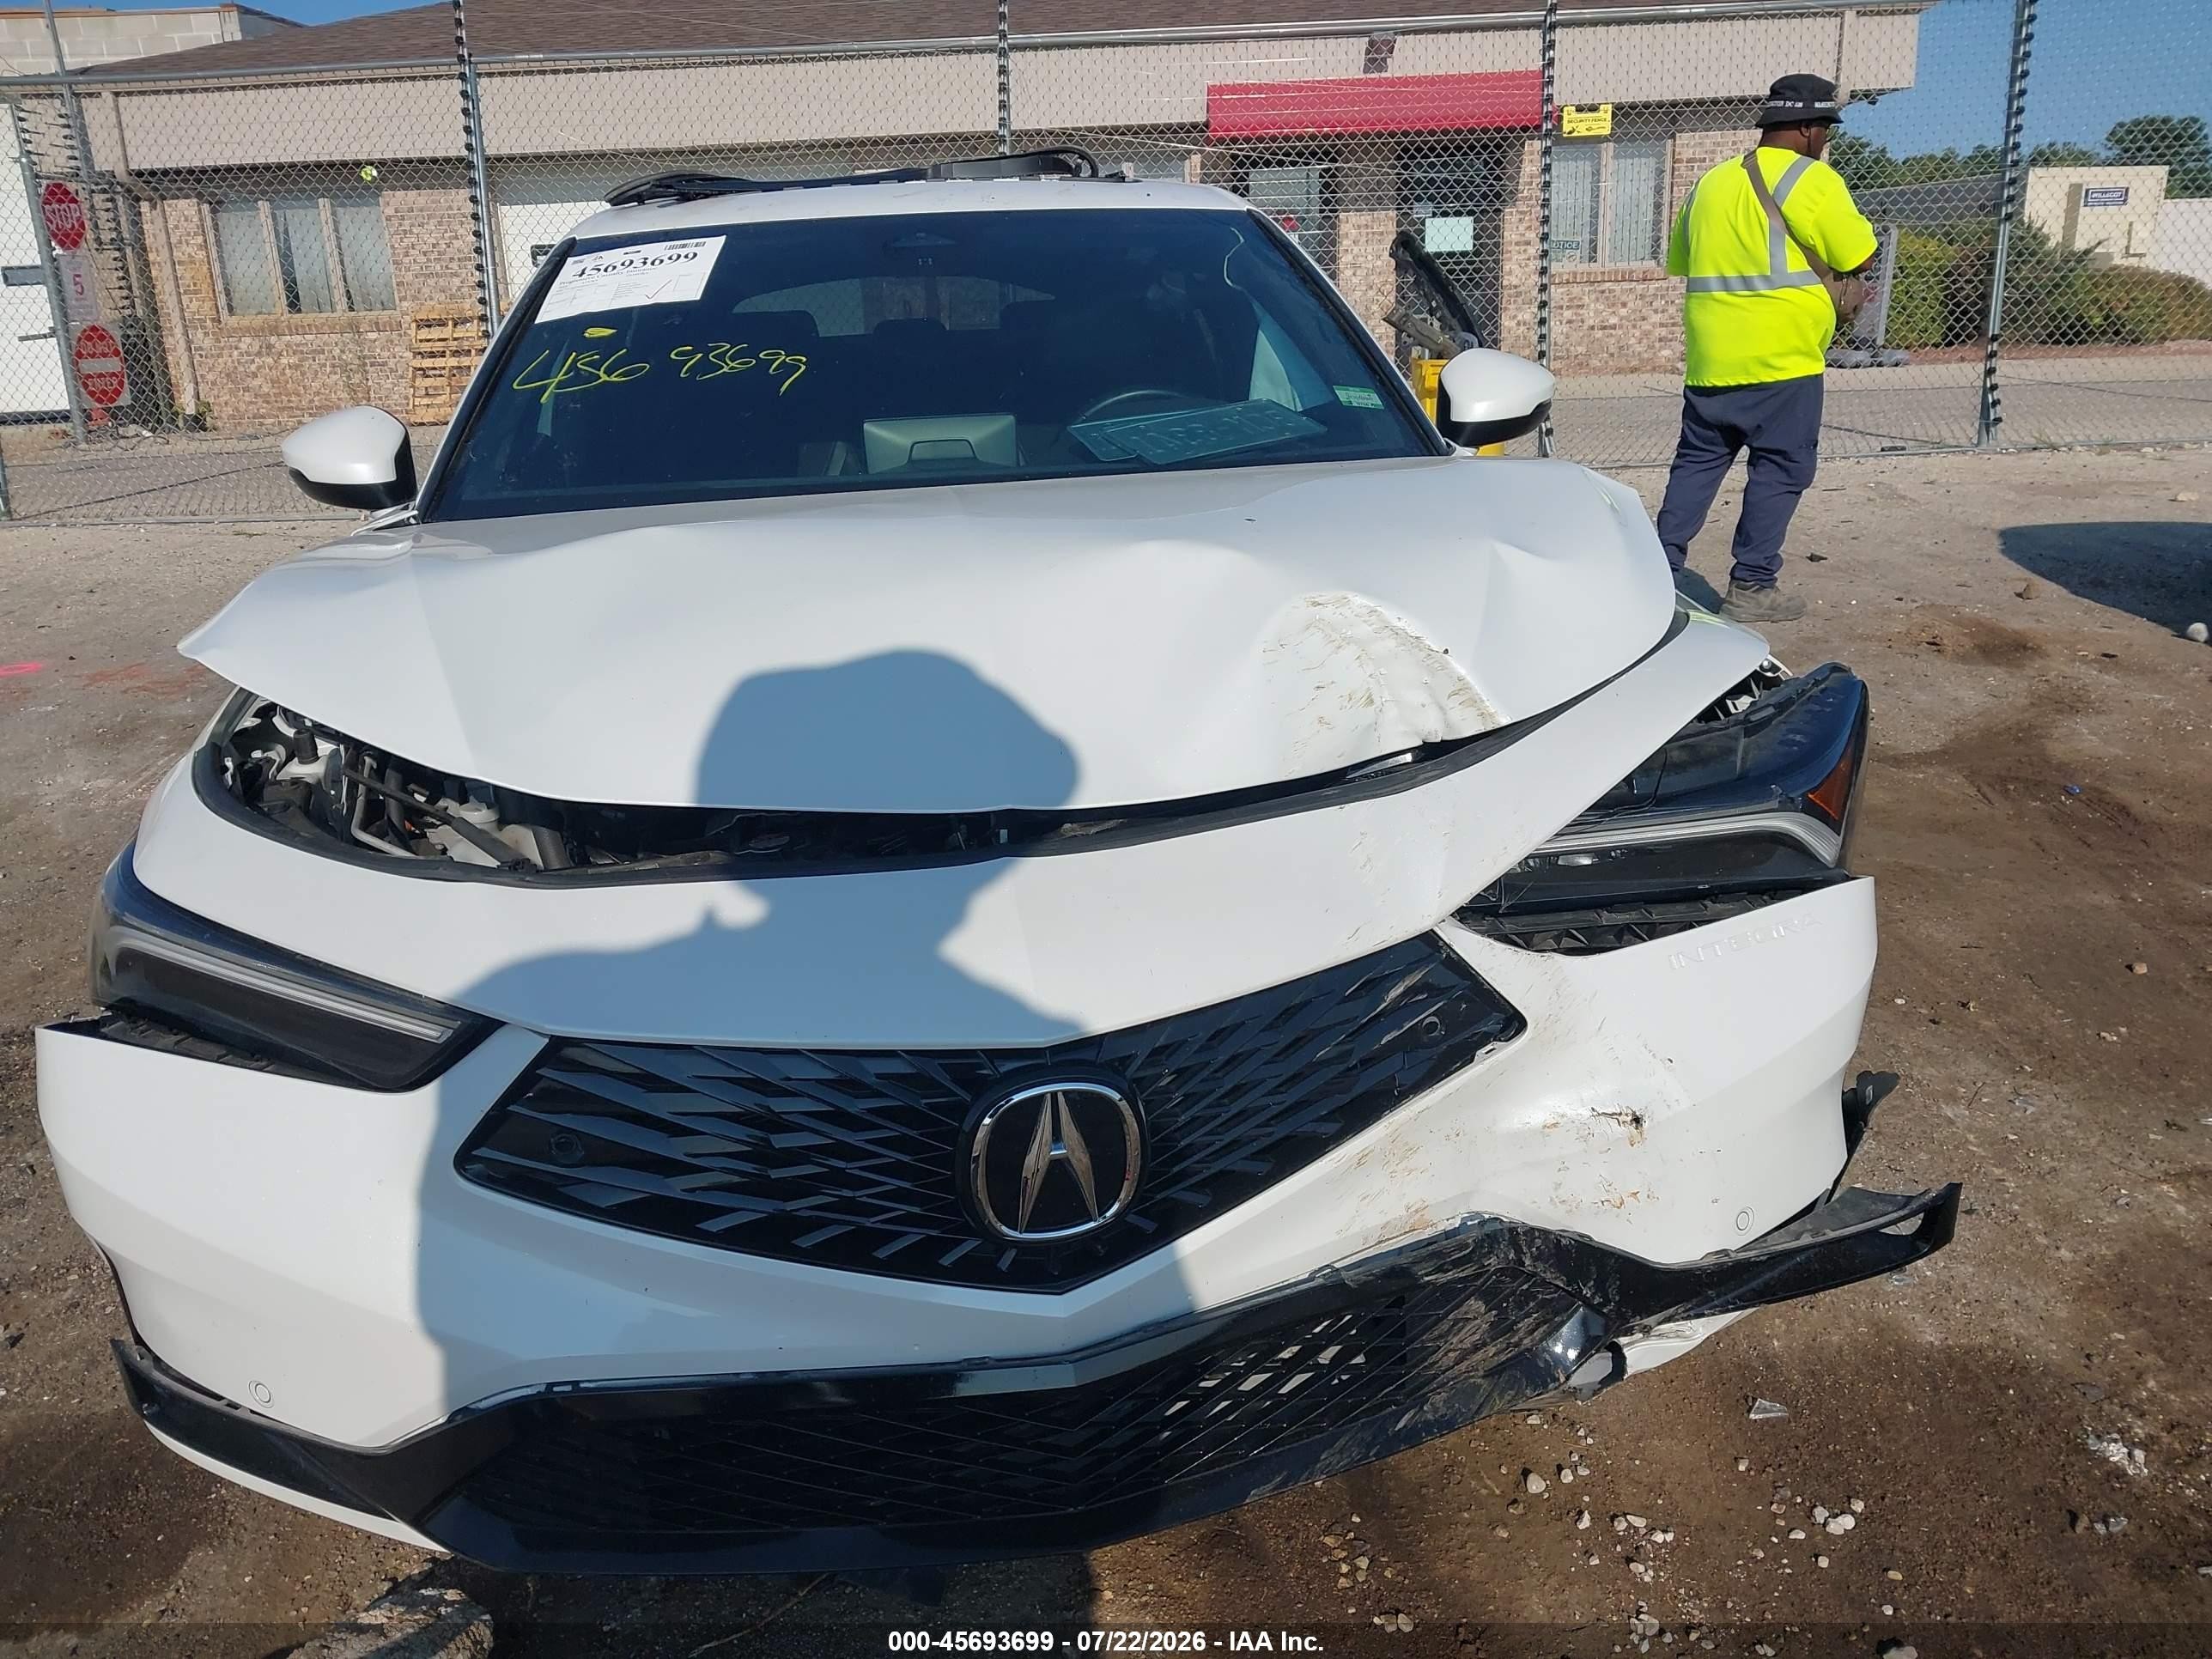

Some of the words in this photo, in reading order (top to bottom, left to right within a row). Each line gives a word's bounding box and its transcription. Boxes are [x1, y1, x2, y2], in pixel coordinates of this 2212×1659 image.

[45, 204, 82, 230] STOP
[572, 252, 698, 279] 45693699
[72, 274, 85, 296] 5
[670, 343, 807, 397] 93699
[1669, 914, 1823, 970] INTEGRA
